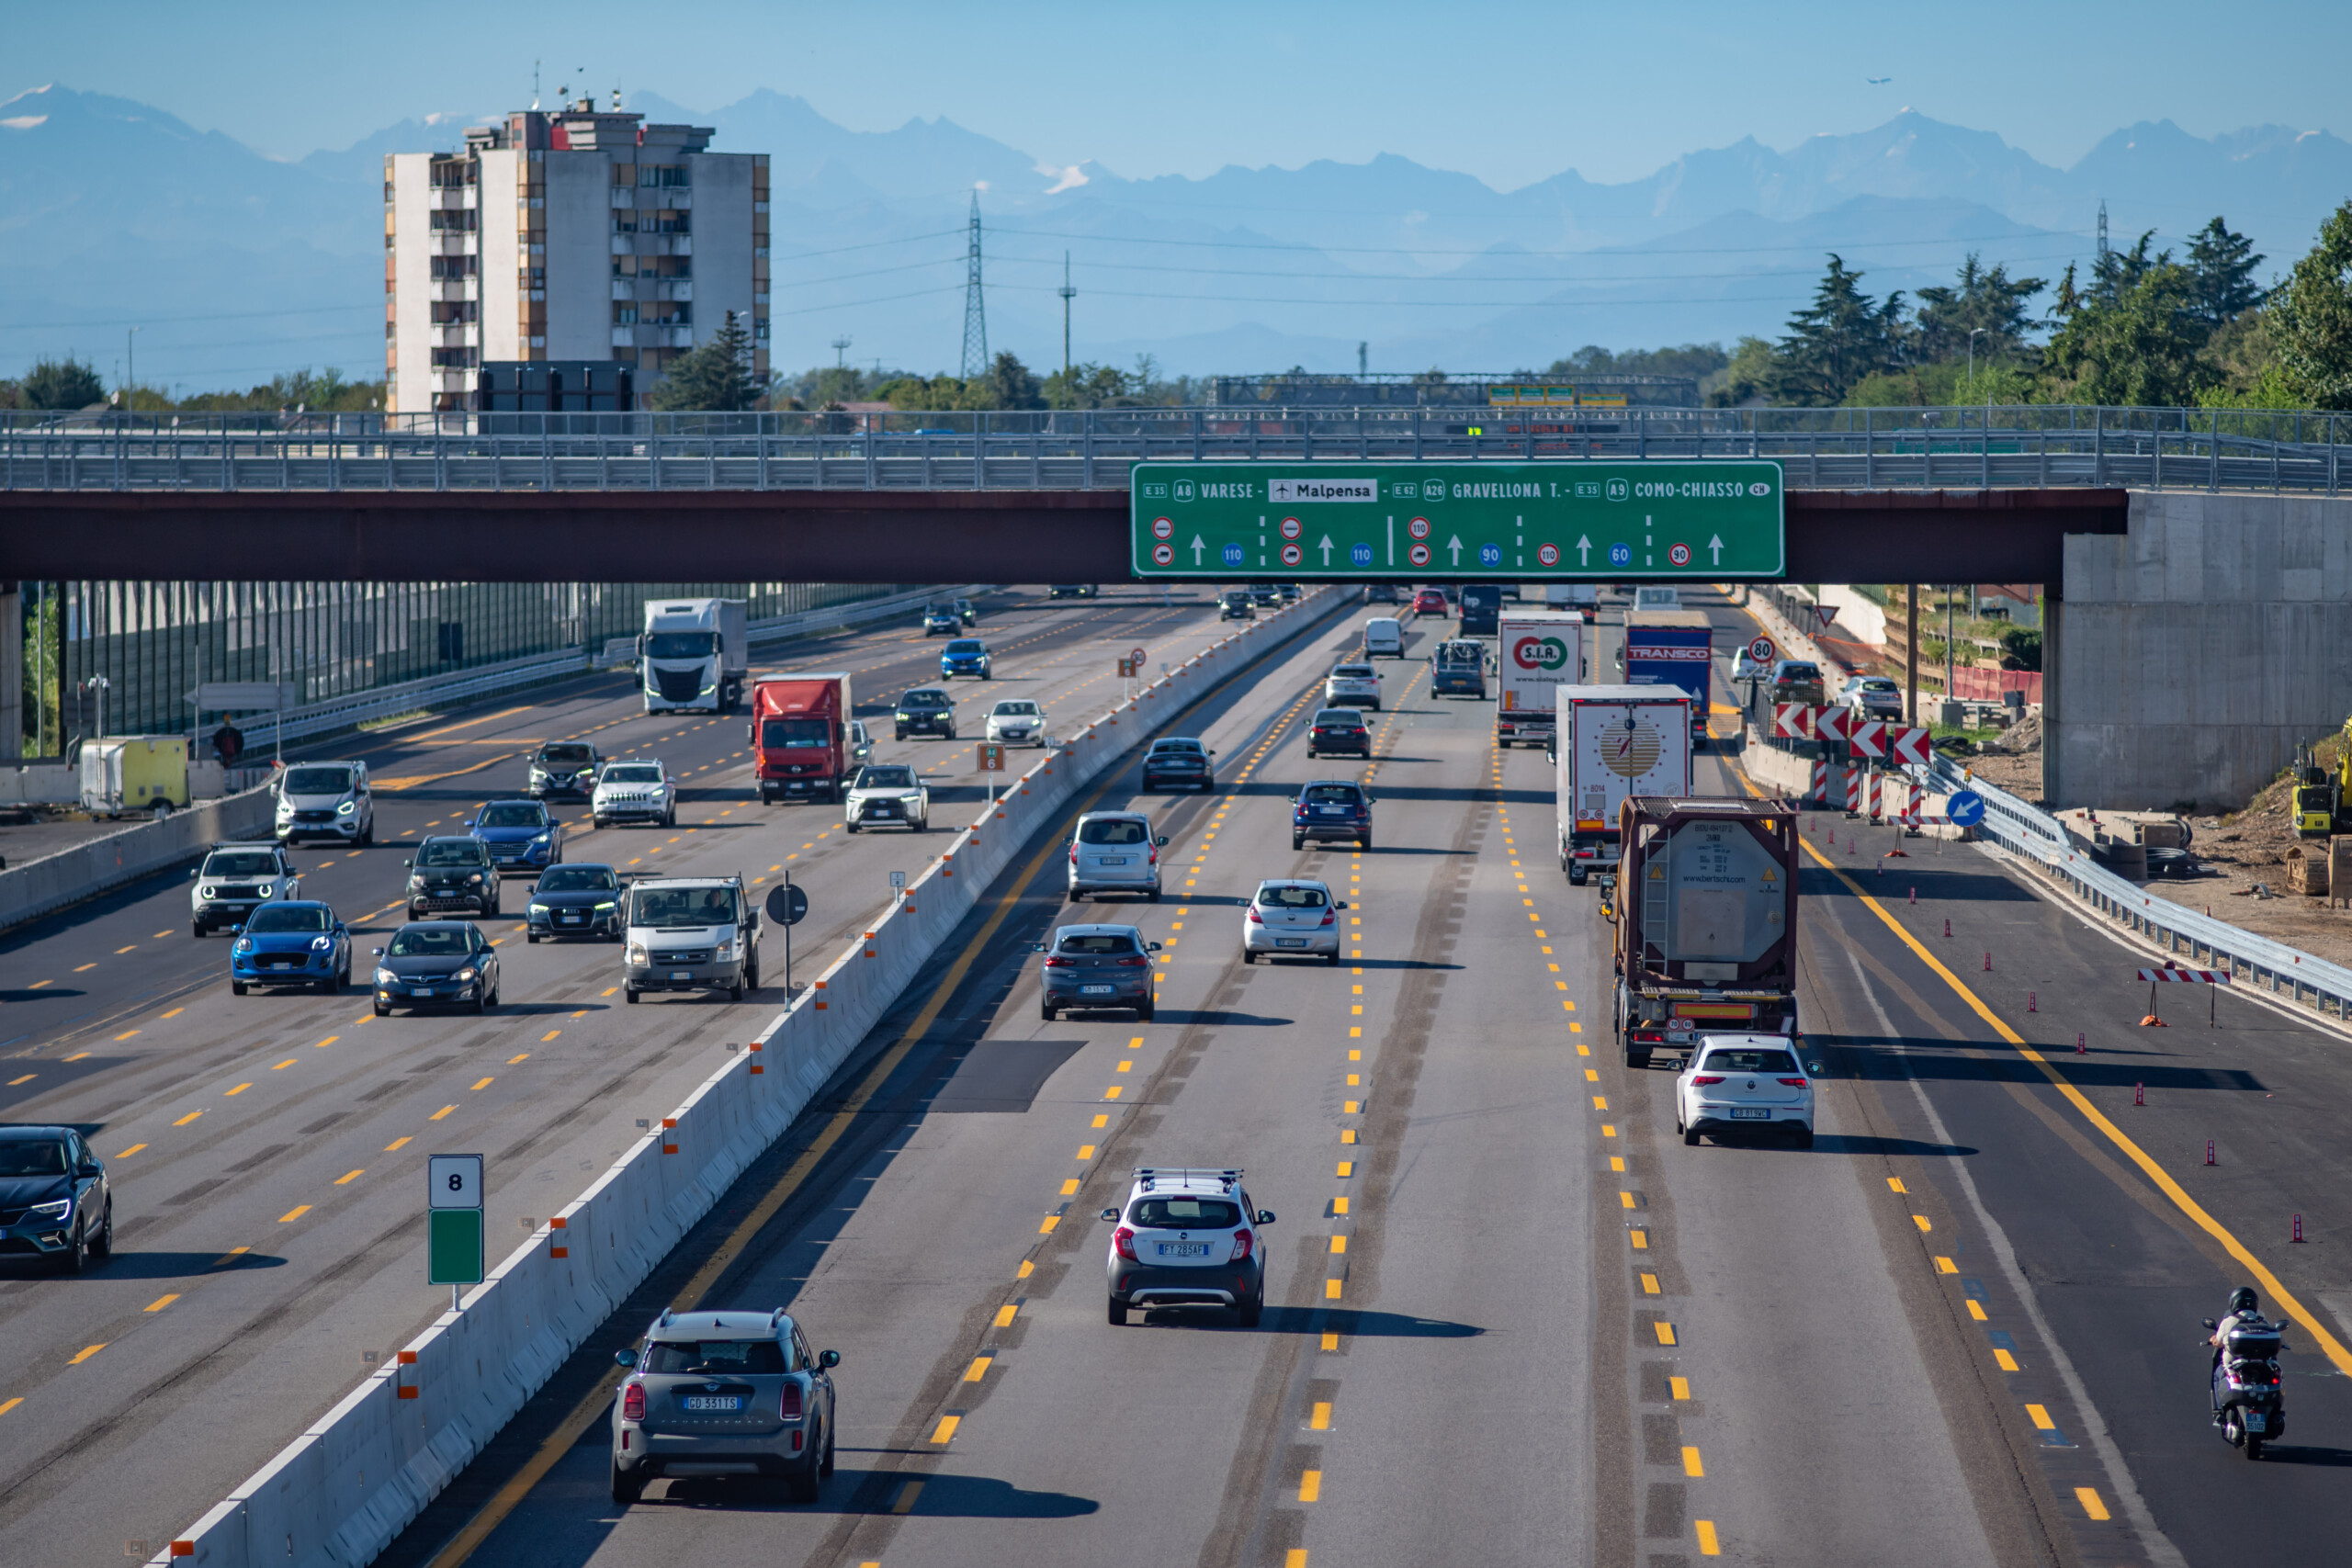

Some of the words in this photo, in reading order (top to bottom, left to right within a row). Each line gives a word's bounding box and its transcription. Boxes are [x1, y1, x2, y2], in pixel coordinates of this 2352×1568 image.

[1145, 486, 1150, 495] E
[1153, 486, 1165, 495] 35
[1176, 485, 1192, 497] A8
[1201, 483, 1253, 499] VARESE
[1297, 484, 1371, 501] Malpensa
[1395, 486, 1401, 495] E
[1404, 486, 1415, 495] 62
[1425, 485, 1443, 497] A26
[1453, 482, 1541, 499] GRAVELLONA
[1550, 482, 1561, 499] T.
[1577, 486, 1584, 494] E
[1587, 486, 1598, 494] 35
[1610, 485, 1625, 496] A9
[1635, 482, 1744, 498] COMO-CHIASSO
[1753, 485, 1766, 495] CH
[1413, 523, 1426, 534] 110
[1225, 548, 1241, 560] 110
[1353, 548, 1370, 560] 110
[1482, 548, 1498, 561] 90
[1542, 550, 1555, 560] 110
[1611, 548, 1628, 561] 60
[1673, 549, 1686, 559] 90
[1525, 647, 1557, 659] S.I.A.
[1629, 649, 1708, 659] TRANSCO
[1754, 643, 1770, 656] 80
[988, 759, 996, 769] 6
[448, 1173, 463, 1191] 8
[1164, 1245, 1174, 1254] FY
[1177, 1245, 1203, 1254] 285AF
[689, 1397, 701, 1409] GD
[705, 1397, 736, 1409] 331TS
